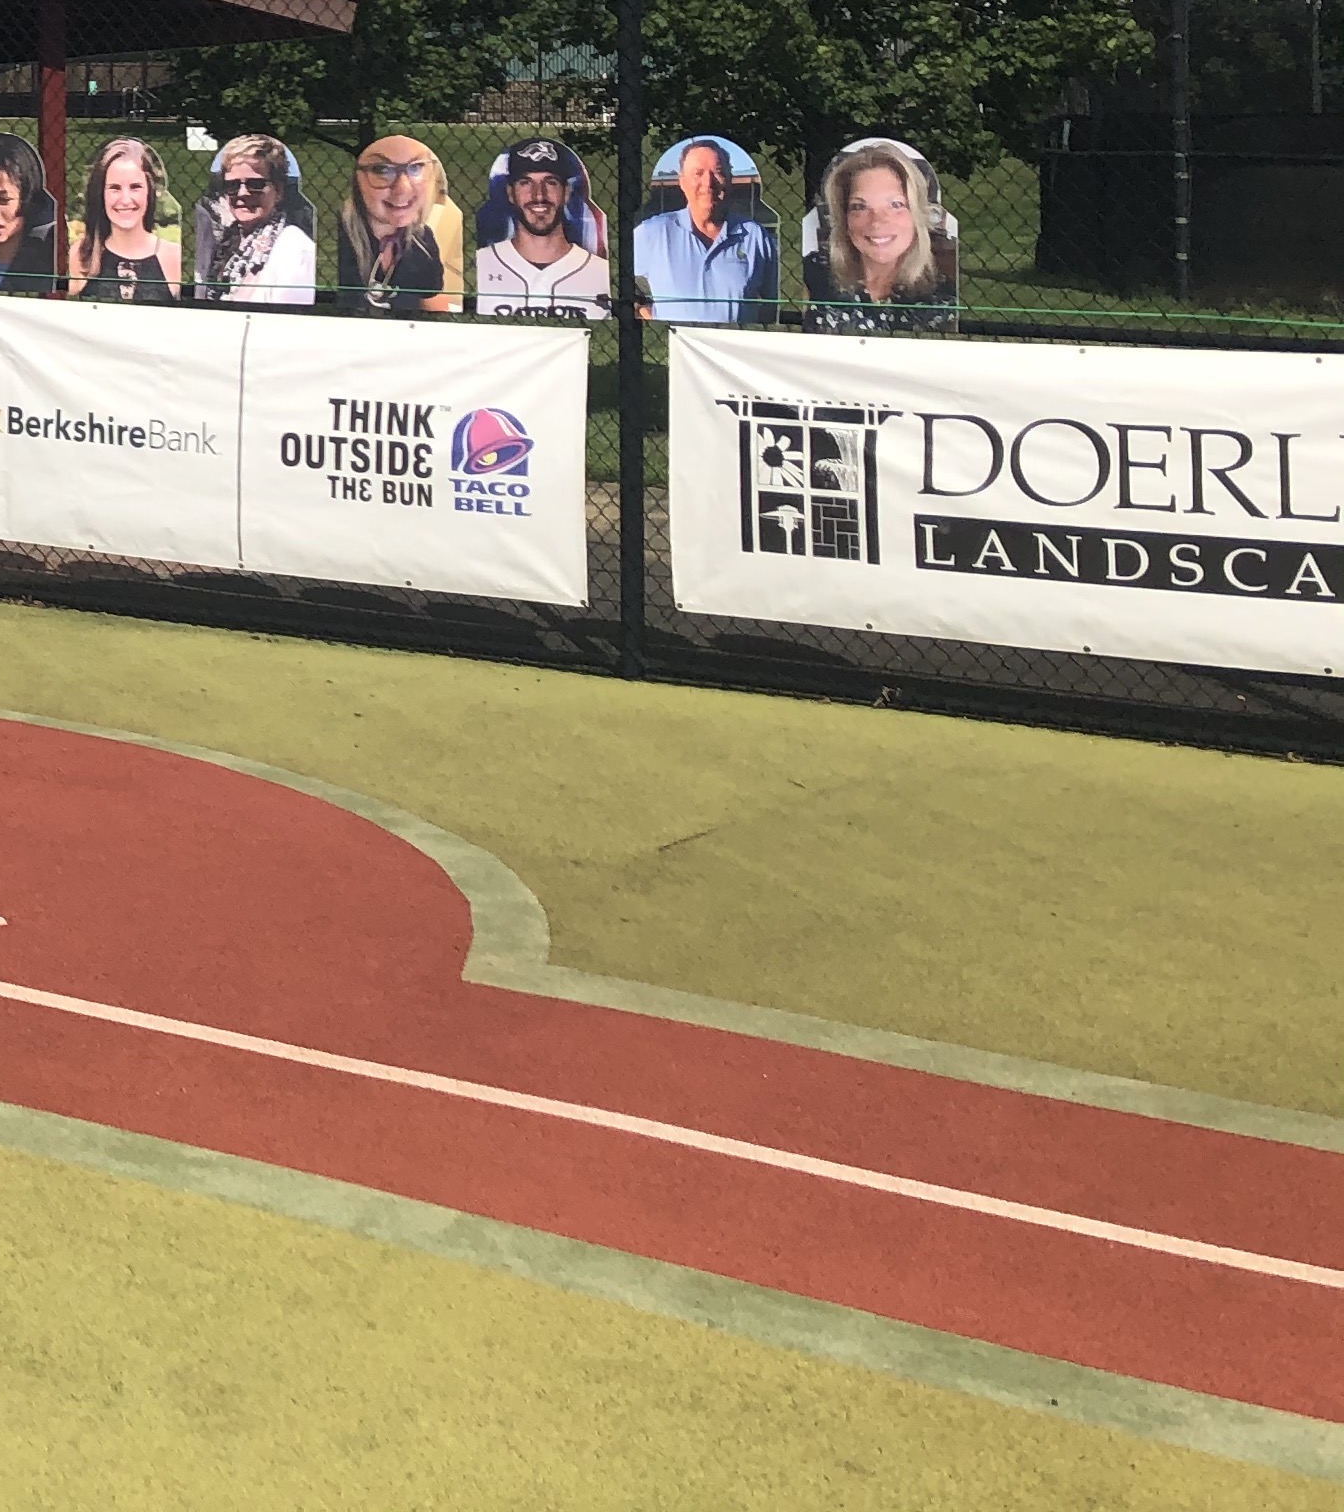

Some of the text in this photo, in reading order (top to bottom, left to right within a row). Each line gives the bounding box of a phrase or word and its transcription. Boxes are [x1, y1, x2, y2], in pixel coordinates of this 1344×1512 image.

[328, 397, 436, 439] THINK
[280, 431, 434, 478] OUTSIDE
[913, 410, 1344, 523] DOERL
[327, 475, 434, 508] THE BUN
[449, 477, 531, 498] TACO
[454, 497, 533, 518] BELL
